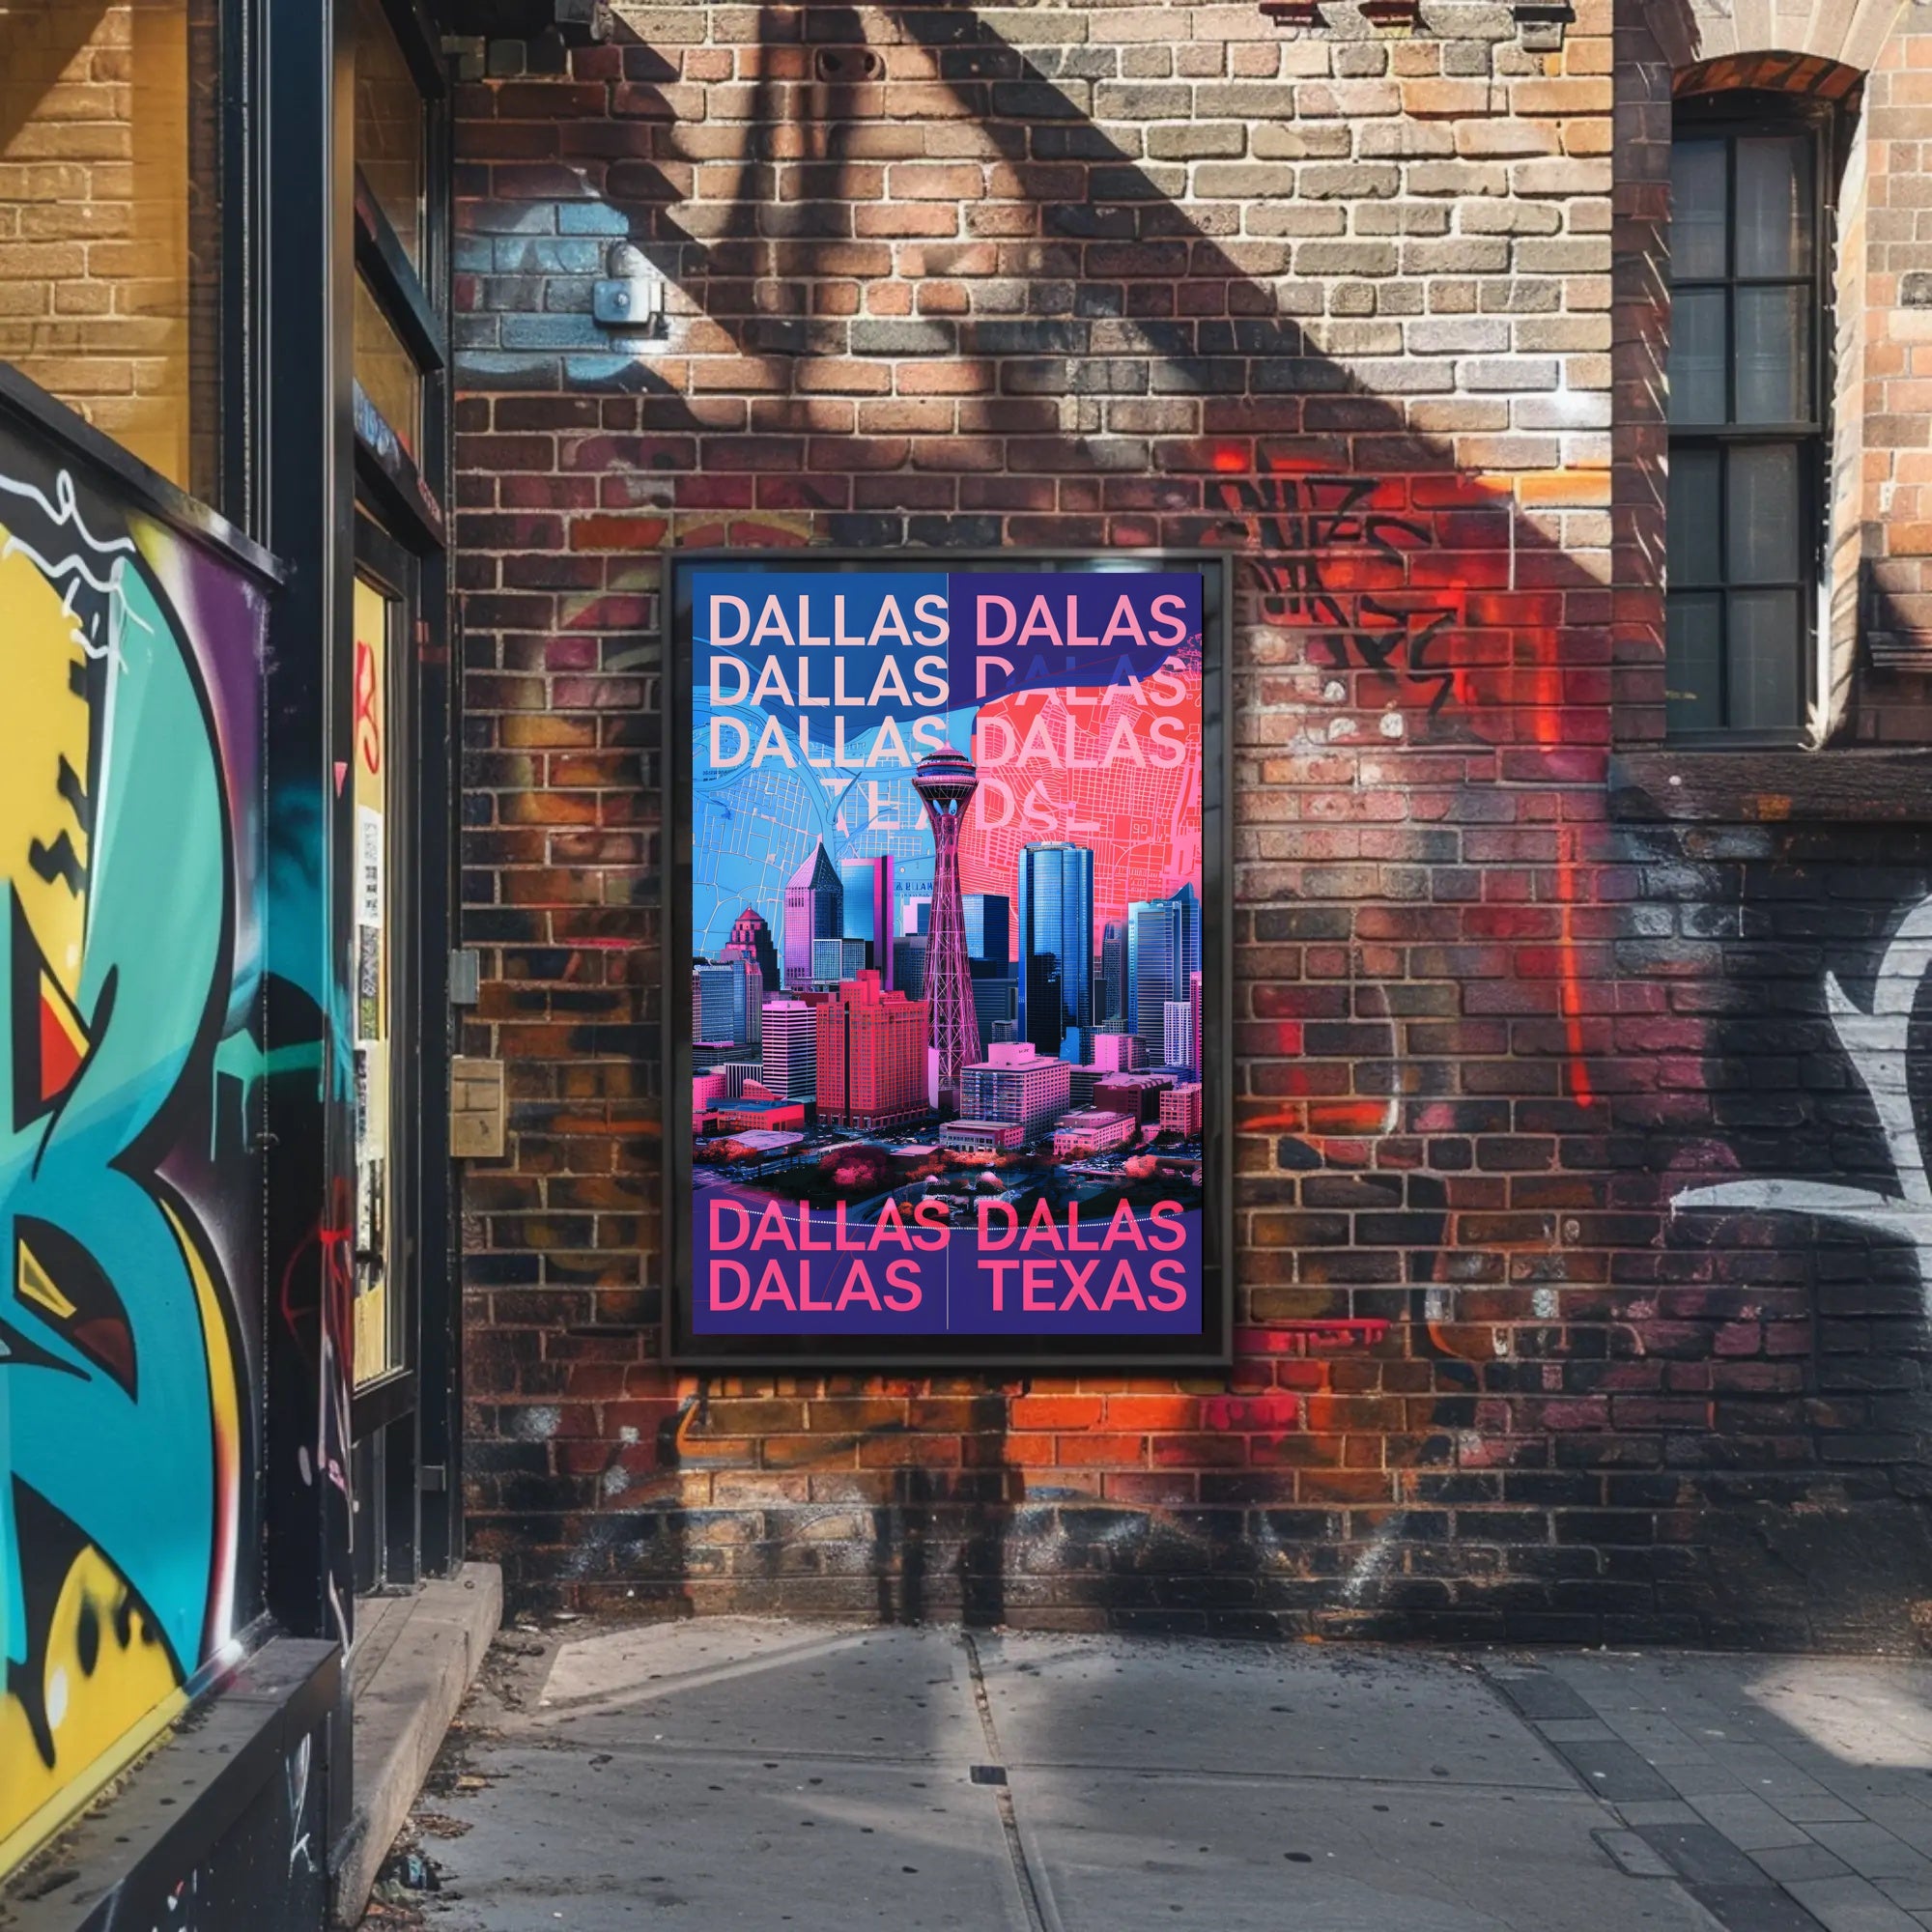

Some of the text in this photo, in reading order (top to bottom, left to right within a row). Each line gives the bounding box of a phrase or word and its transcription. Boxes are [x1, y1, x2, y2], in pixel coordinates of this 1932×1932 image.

[710, 595, 1187, 646] DALLAS DALAS
[710, 655, 950, 707] DALLAS
[710, 715, 1187, 769] DALLAS DALAS
[710, 1198, 1187, 1252] DALLAS DALAS
[710, 1259, 1187, 1312] DALAS TEXAS
